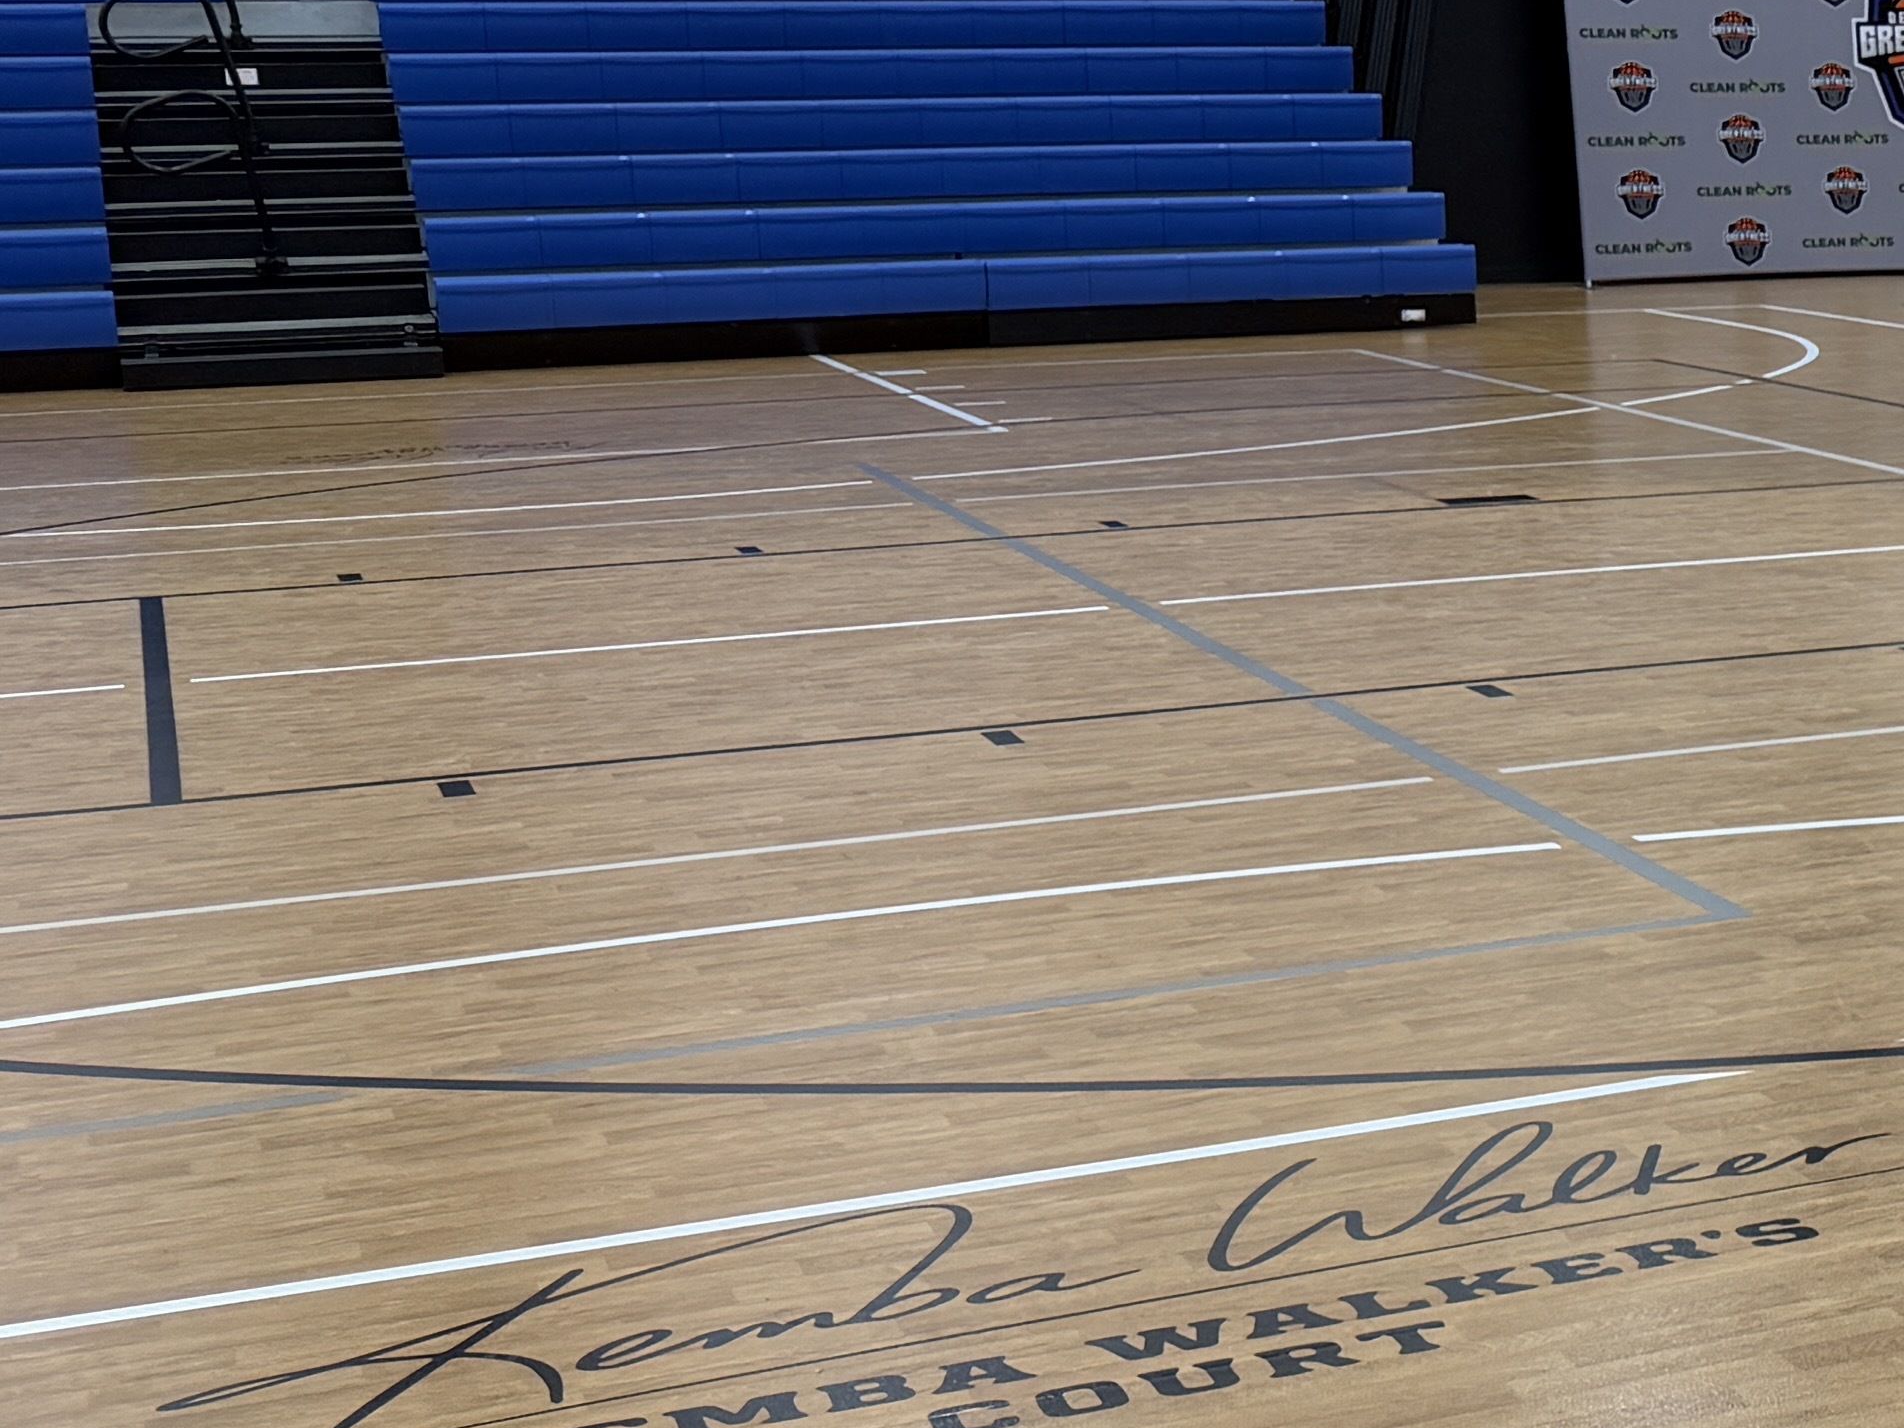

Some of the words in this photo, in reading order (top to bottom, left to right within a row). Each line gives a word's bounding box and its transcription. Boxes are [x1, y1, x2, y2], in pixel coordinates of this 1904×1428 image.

[1579, 28, 1626, 39] CLEAN
[1690, 82, 1735, 94] CLEAN
[1588, 136, 1634, 148] CLEAN
[1796, 134, 1840, 145] CLEAN
[1696, 185, 1742, 197] CLEAN
[1802, 236, 1846, 248] CLEAN
[1595, 243, 1642, 254] CLEAN
[1206, 1119, 1894, 1274] Walker
[1090, 1216, 1821, 1359] WALKER'S
